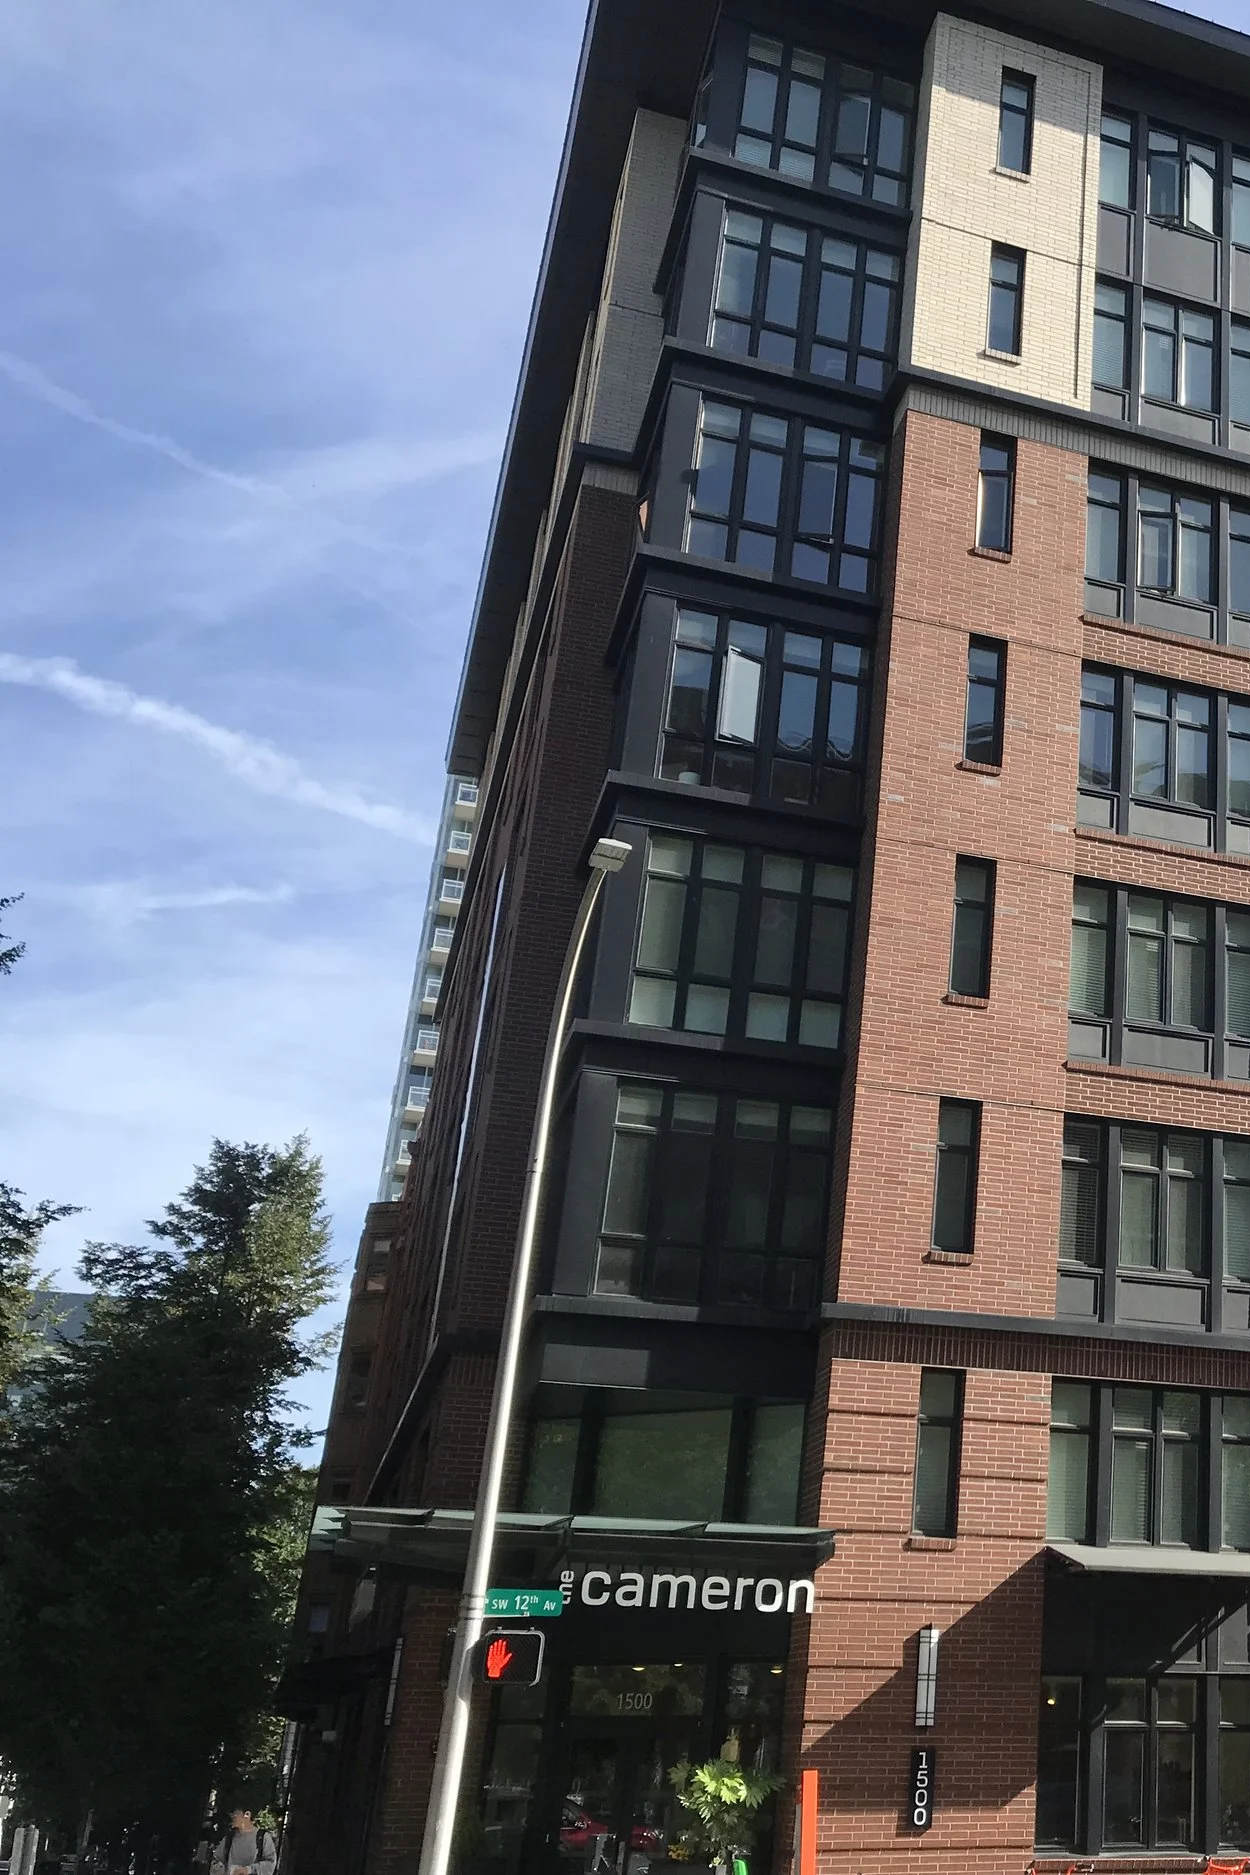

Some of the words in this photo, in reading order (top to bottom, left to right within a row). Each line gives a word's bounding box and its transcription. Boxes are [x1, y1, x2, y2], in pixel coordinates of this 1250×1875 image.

[491, 1598, 509, 1610] SW
[514, 1595, 539, 1611] 12th
[543, 1600, 557, 1611] Av
[580, 1569, 815, 1614] cameron
[617, 1692, 653, 1710] 1500
[913, 1751, 929, 1826] 1500
